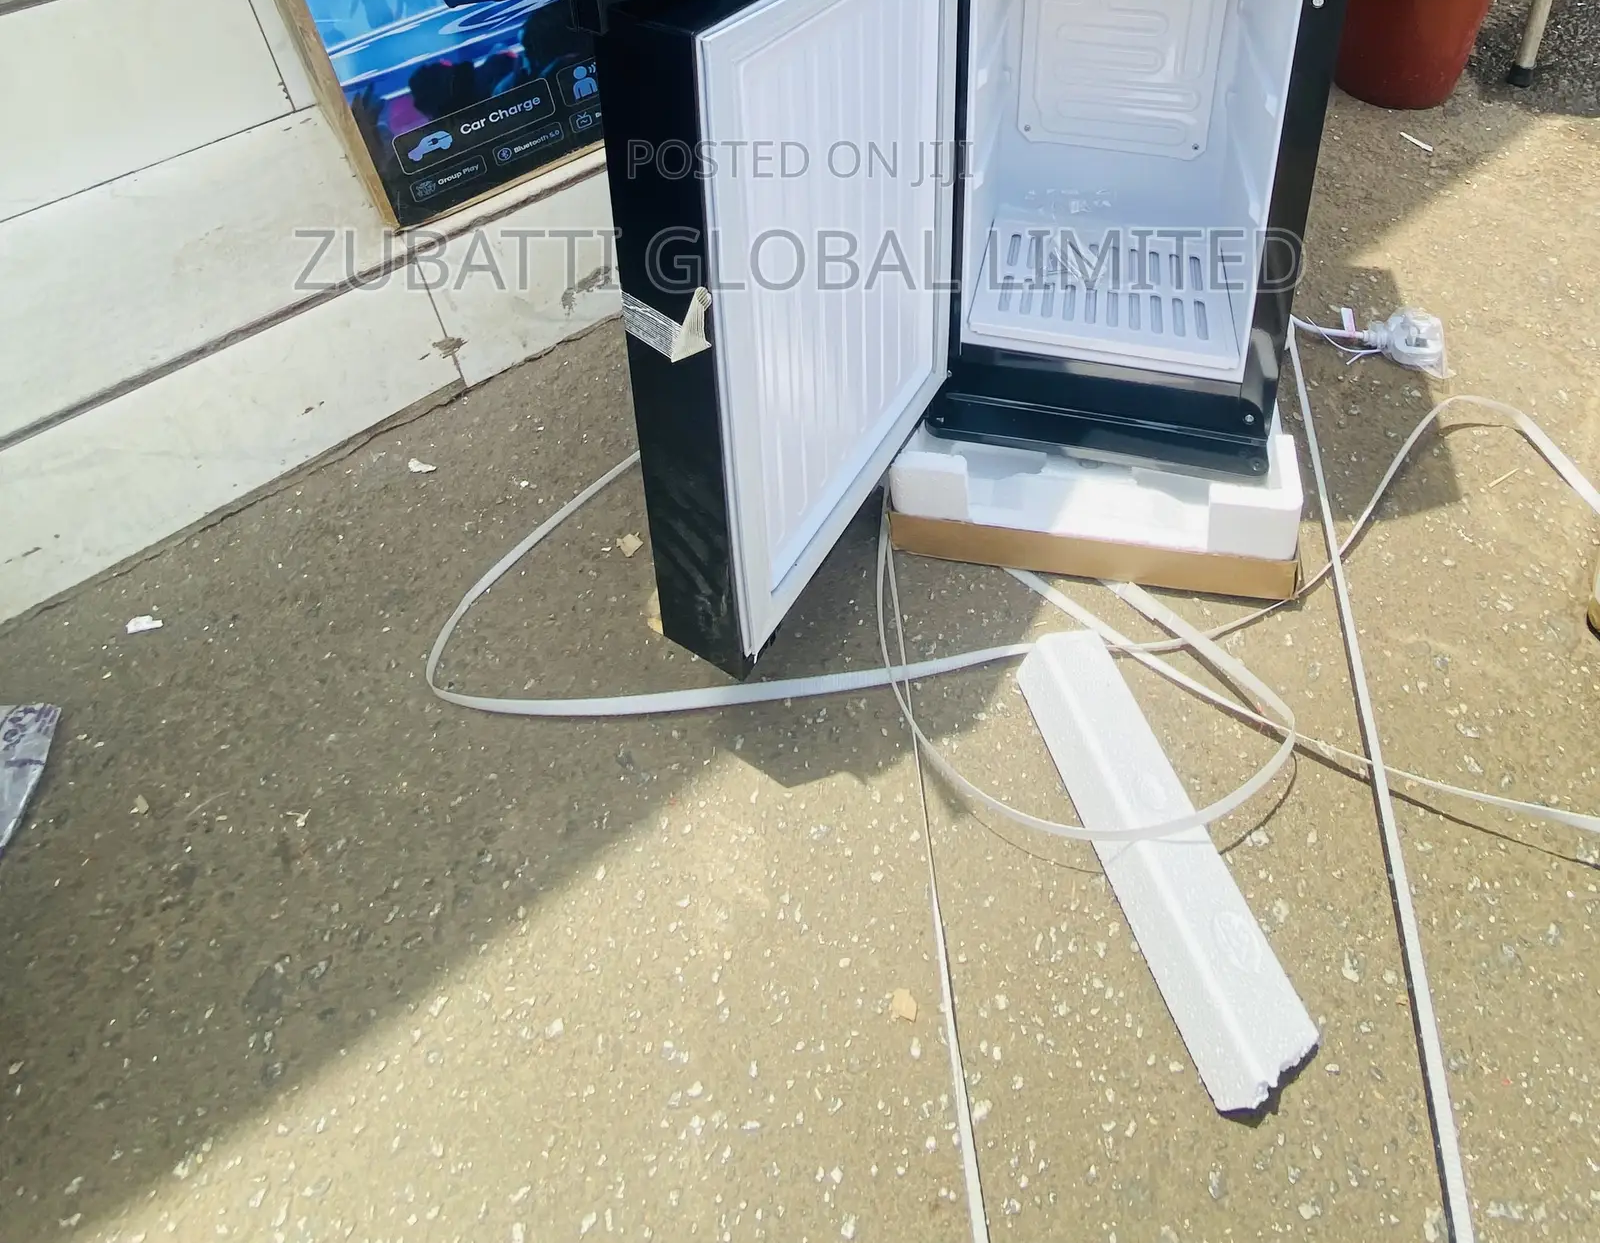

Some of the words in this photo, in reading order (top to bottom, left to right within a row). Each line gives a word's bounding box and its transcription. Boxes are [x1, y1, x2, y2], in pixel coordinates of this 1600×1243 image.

[460, 118, 486, 135] Car
[489, 96, 541, 122] Charge
[514, 134, 549, 154] Bluetooth
[437, 172, 462, 186] Group
[462, 163, 480, 176] Play
